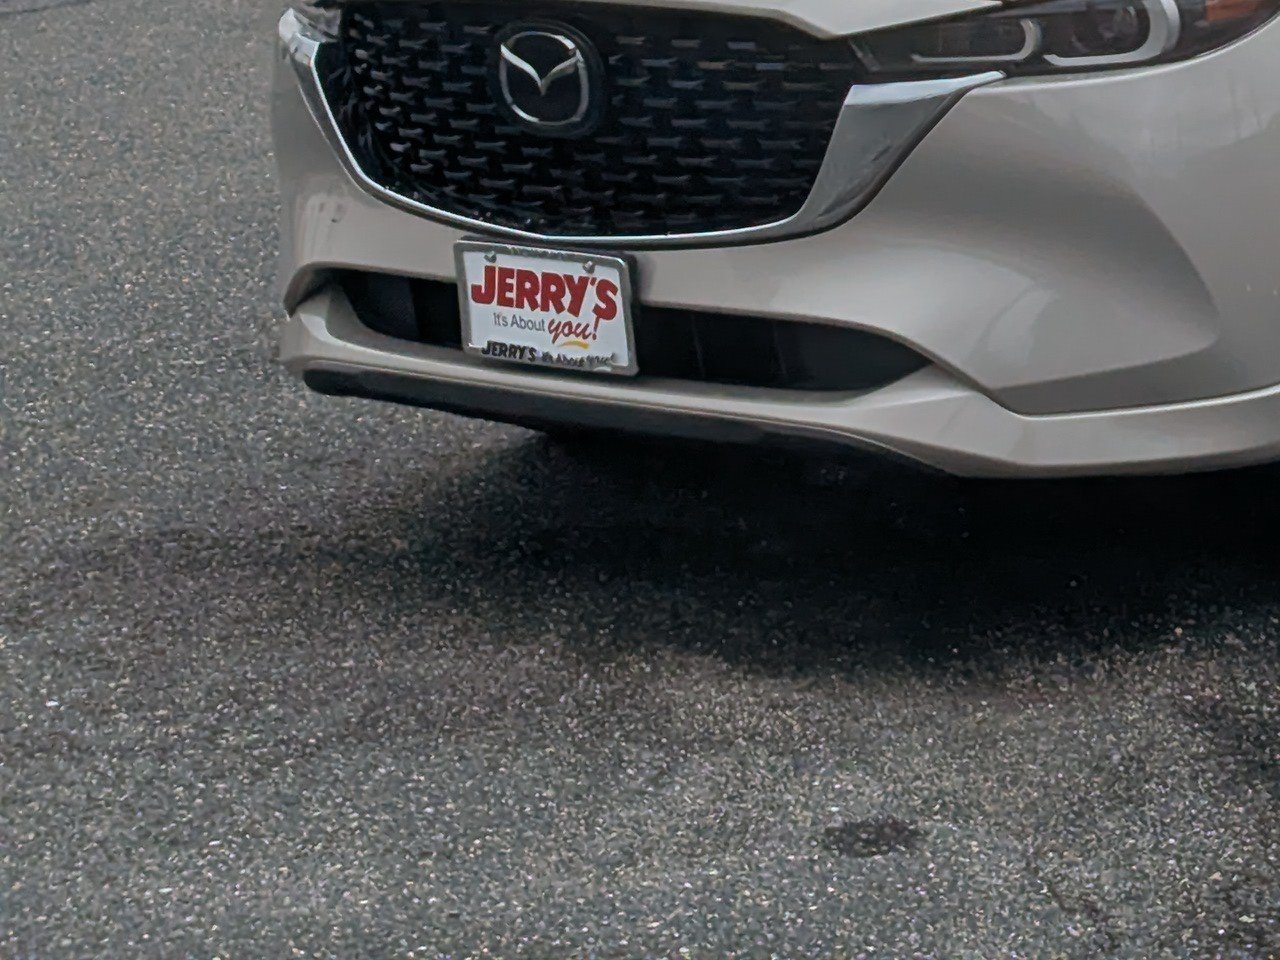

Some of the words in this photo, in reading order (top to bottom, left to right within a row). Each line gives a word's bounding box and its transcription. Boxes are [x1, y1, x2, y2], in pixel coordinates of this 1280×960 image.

[470, 265, 619, 321] JERRY'S
[493, 312, 509, 327] It's
[510, 313, 546, 333] About
[547, 316, 600, 345] you!
[481, 340, 537, 363] JERRY'S
